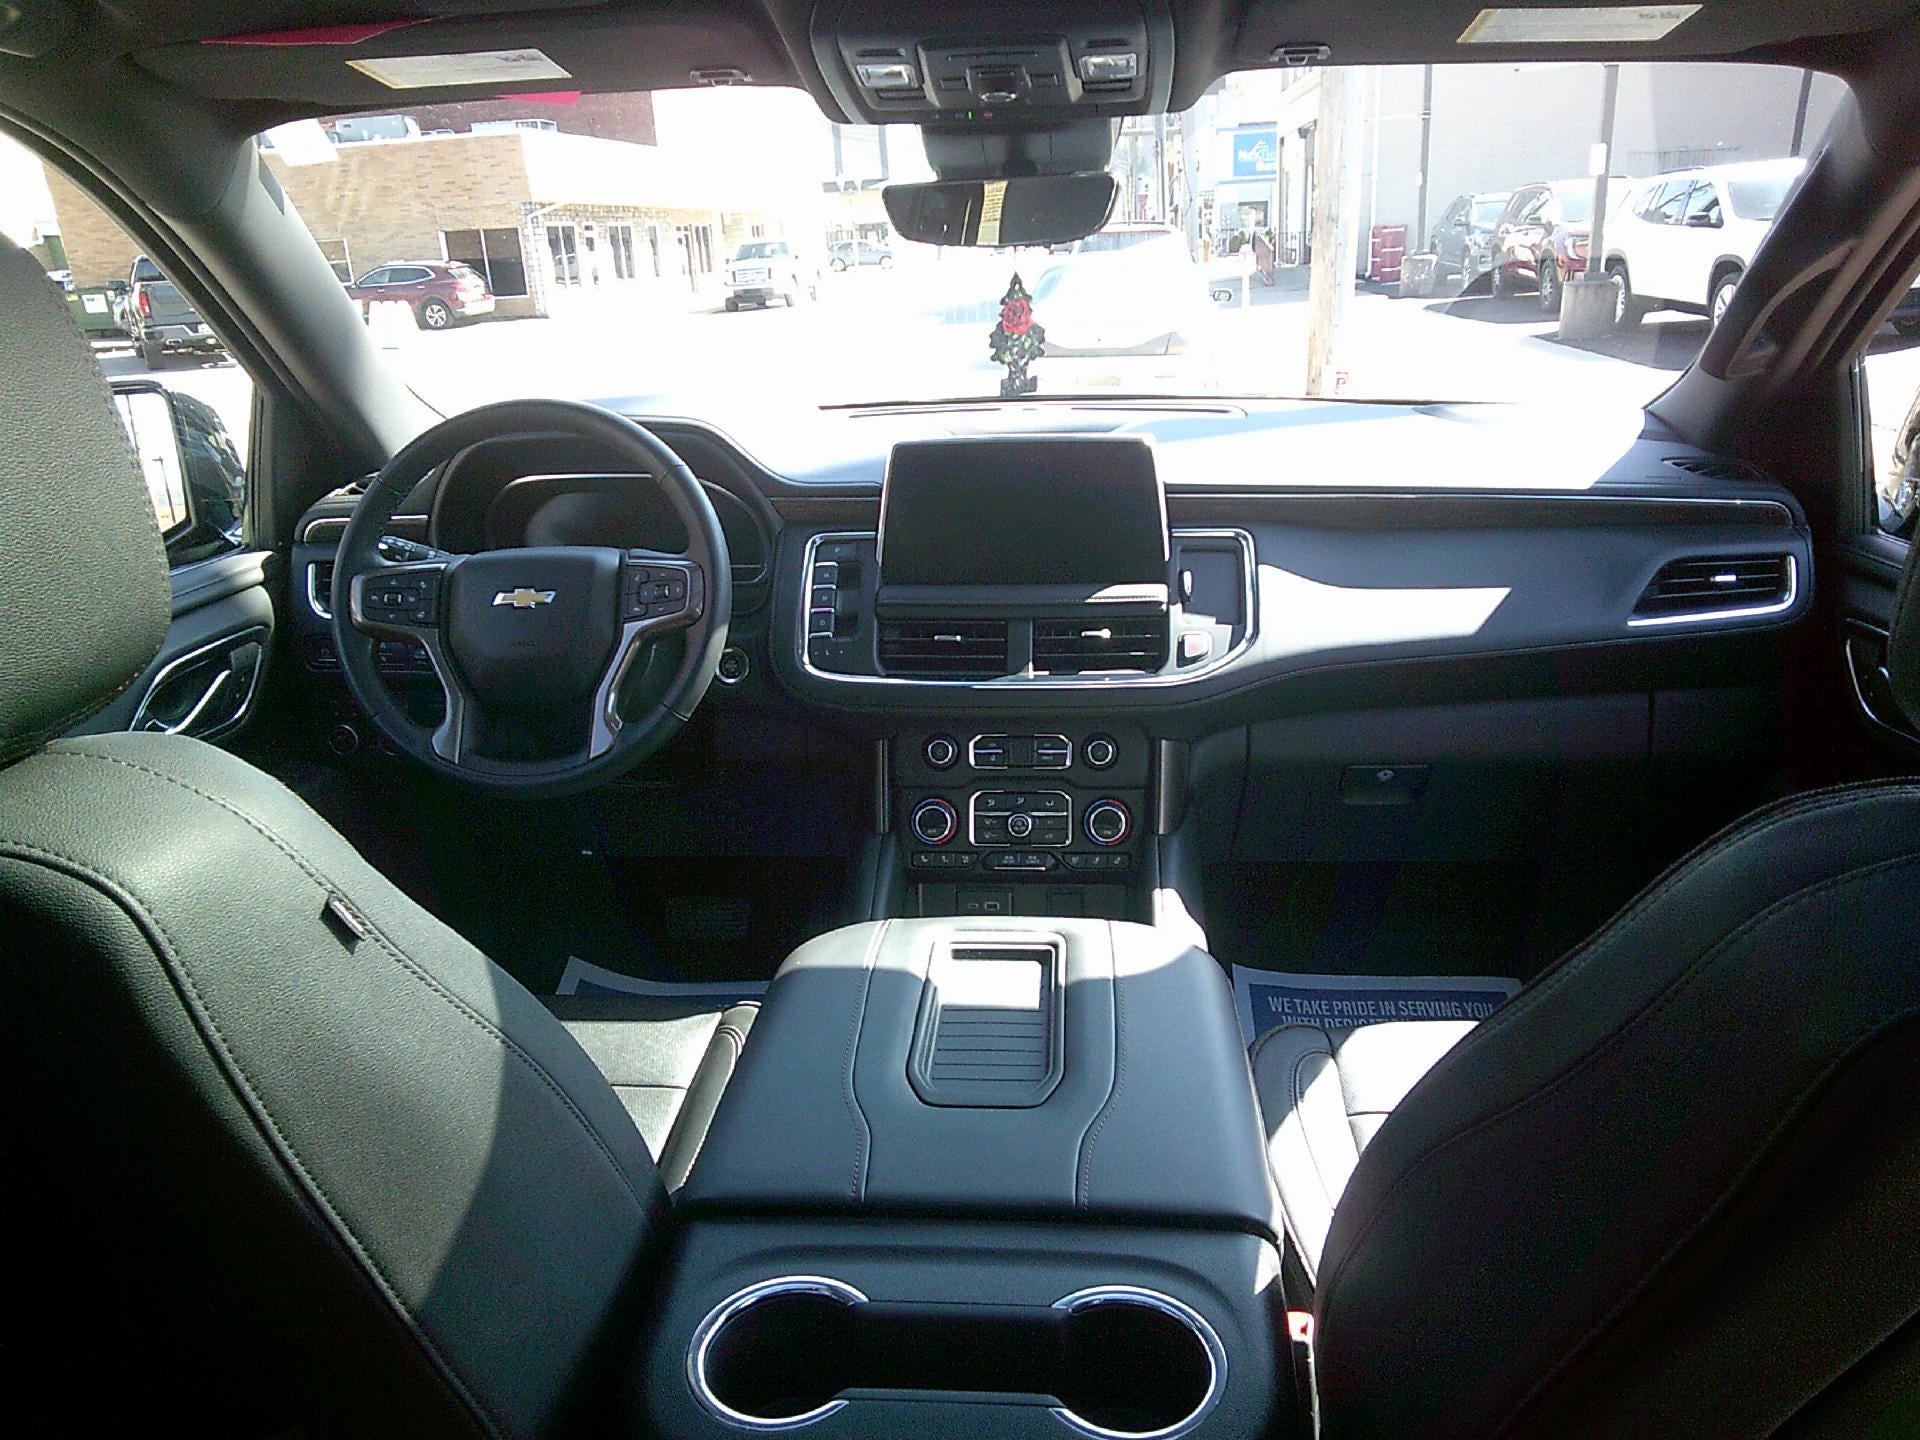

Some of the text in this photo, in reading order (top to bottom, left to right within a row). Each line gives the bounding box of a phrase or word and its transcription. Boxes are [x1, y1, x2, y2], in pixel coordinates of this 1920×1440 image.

[1268, 995, 1292, 1013] WE
[1293, 998, 1331, 1015] TAKE
[1332, 1000, 1377, 1016] PRIDE
[1378, 1000, 1396, 1016] IN
[1398, 1000, 1463, 1017] SERVING
